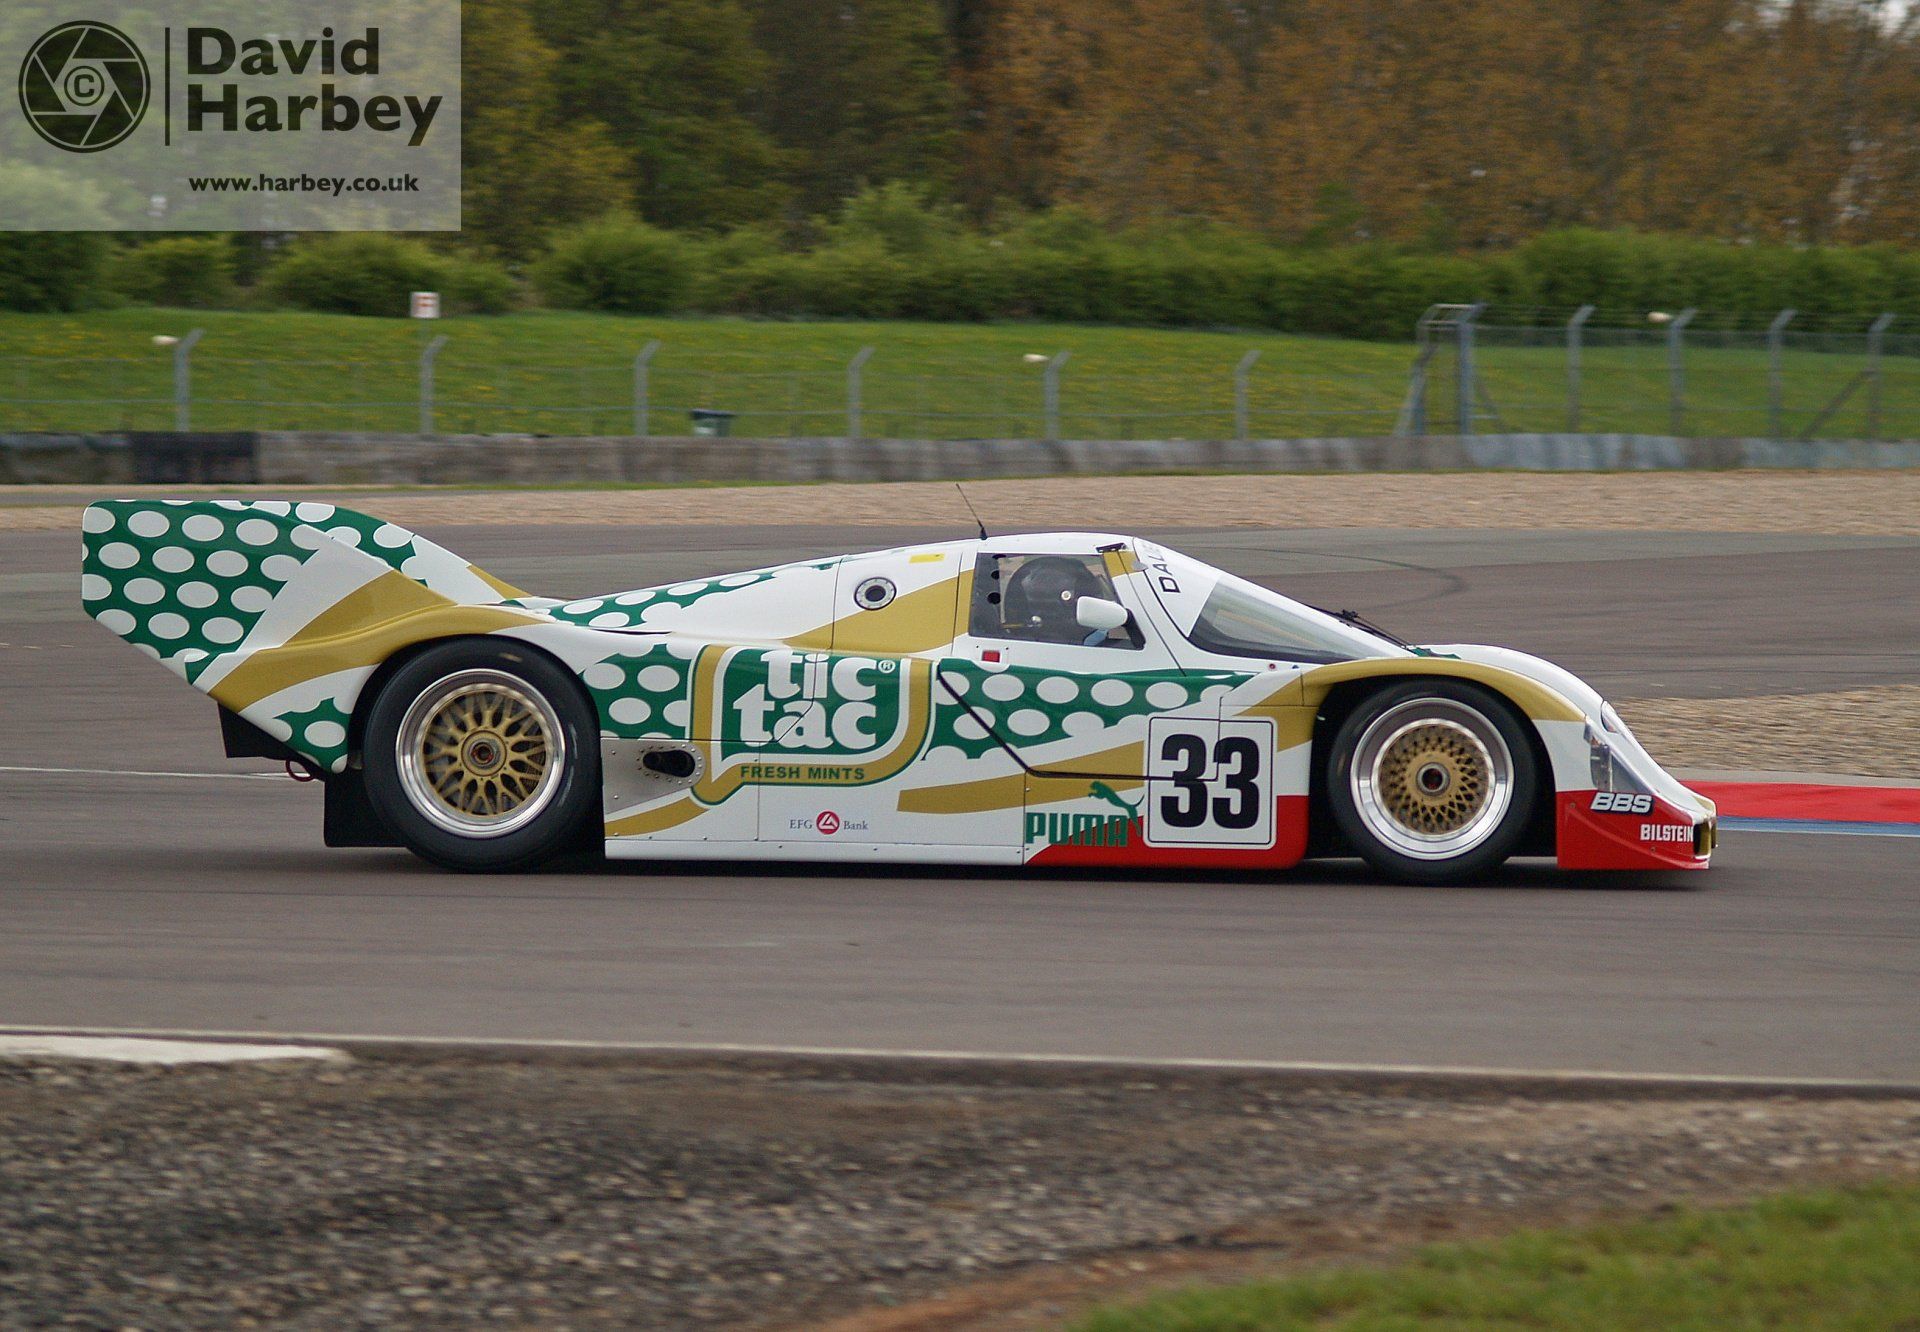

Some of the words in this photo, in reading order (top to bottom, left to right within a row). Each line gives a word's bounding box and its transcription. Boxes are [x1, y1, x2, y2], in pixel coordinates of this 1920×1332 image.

[733, 684, 877, 750] tac
[740, 766, 800, 779] FRESH
[808, 767, 865, 780] MINTS
[1161, 734, 1260, 829] 33
[1590, 792, 1653, 814] BBS
[789, 819, 813, 830] EFG
[843, 820, 869, 831] Bank
[1026, 812, 1129, 847] PUMA
